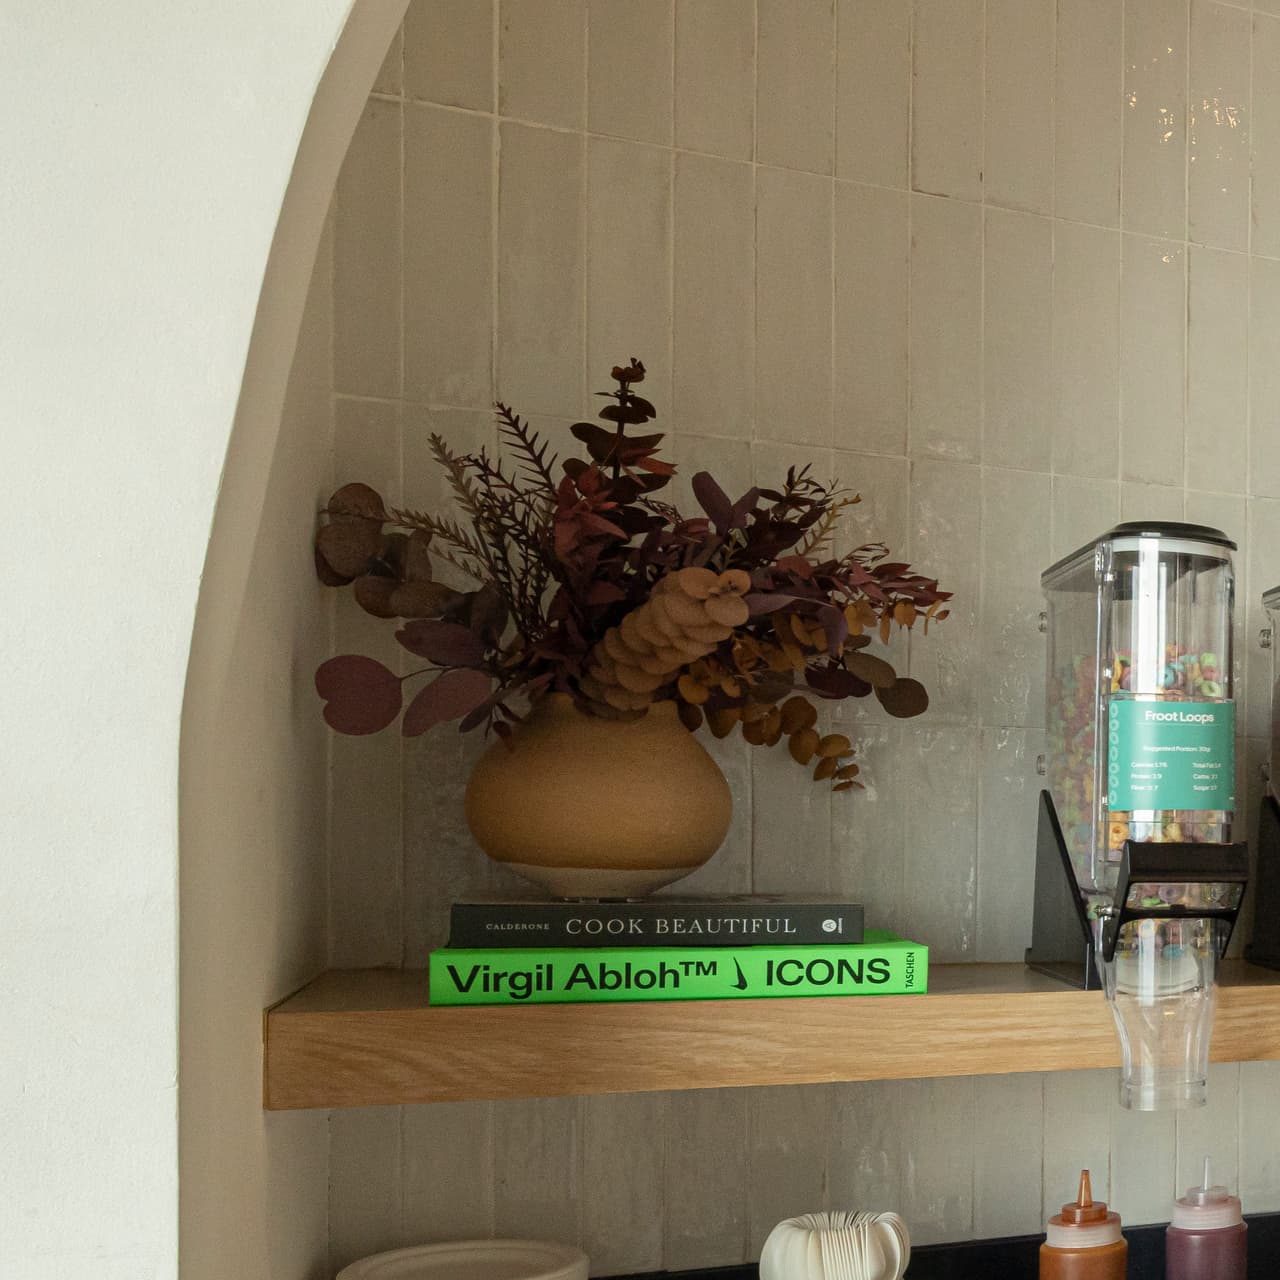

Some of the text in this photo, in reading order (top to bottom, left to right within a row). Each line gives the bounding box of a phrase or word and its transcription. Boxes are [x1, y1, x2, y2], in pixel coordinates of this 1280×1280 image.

[1145, 710, 1214, 724] Froot Loops
[486, 918, 797, 935] CALDERONE COOK BEAUTIFUL
[446, 964, 553, 999] Virgil
[766, 958, 890, 986] ICONS
[905, 952, 915, 988] TASCHEN
